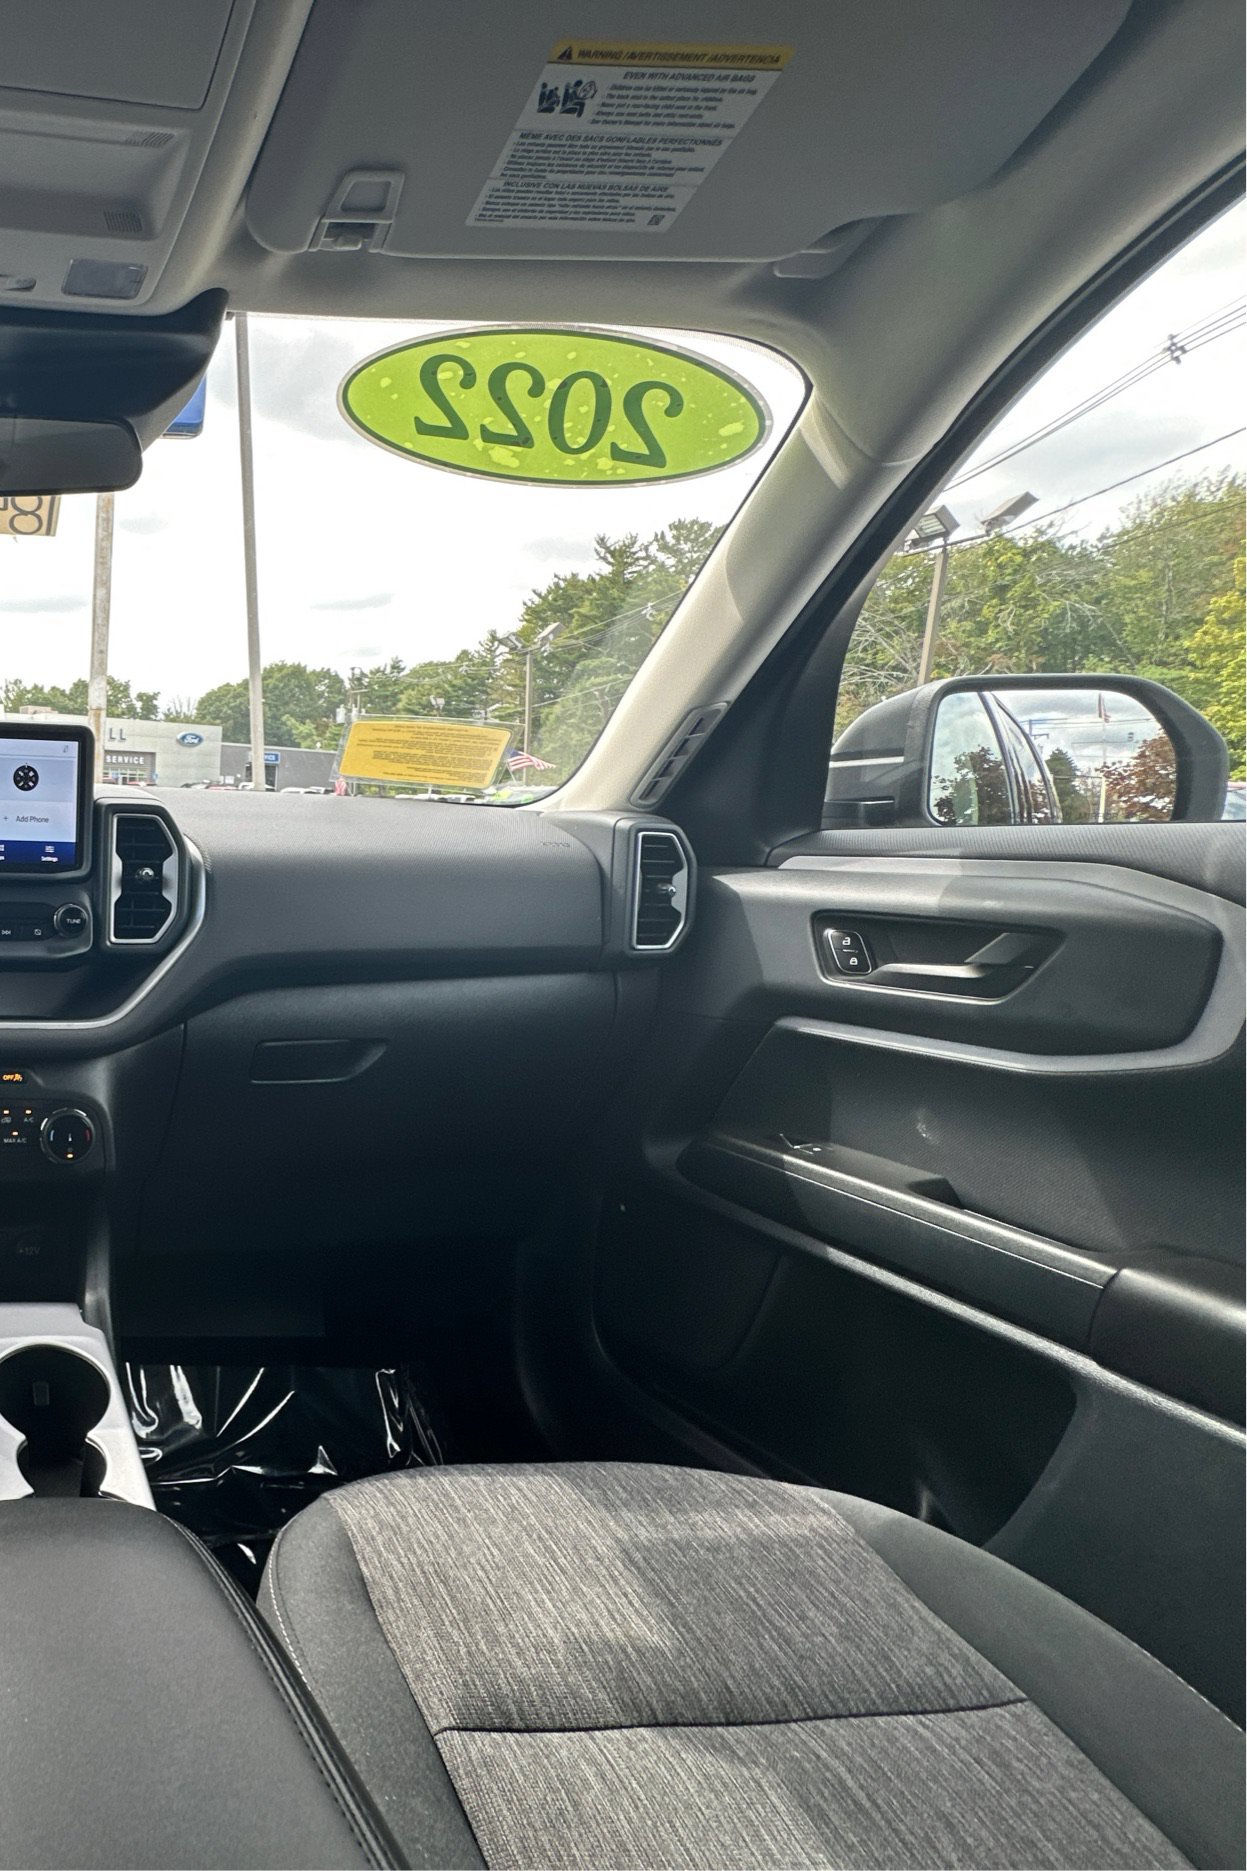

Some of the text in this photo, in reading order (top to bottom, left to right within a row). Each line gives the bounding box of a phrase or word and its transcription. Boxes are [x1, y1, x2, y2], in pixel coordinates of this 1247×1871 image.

[577, 49, 623, 60] WARNING
[623, 72, 757, 83] EVEN WITH ADVANCED AIR BAGS
[582, 135, 605, 143] SACS
[605, 136, 657, 145] GONFLABLES
[503, 181, 543, 189] INCLUSIVE
[105, 755, 145, 765] SERVICE
[16, 816, 50, 824] Add Phone
[2, 1074, 14, 1082] OFF
